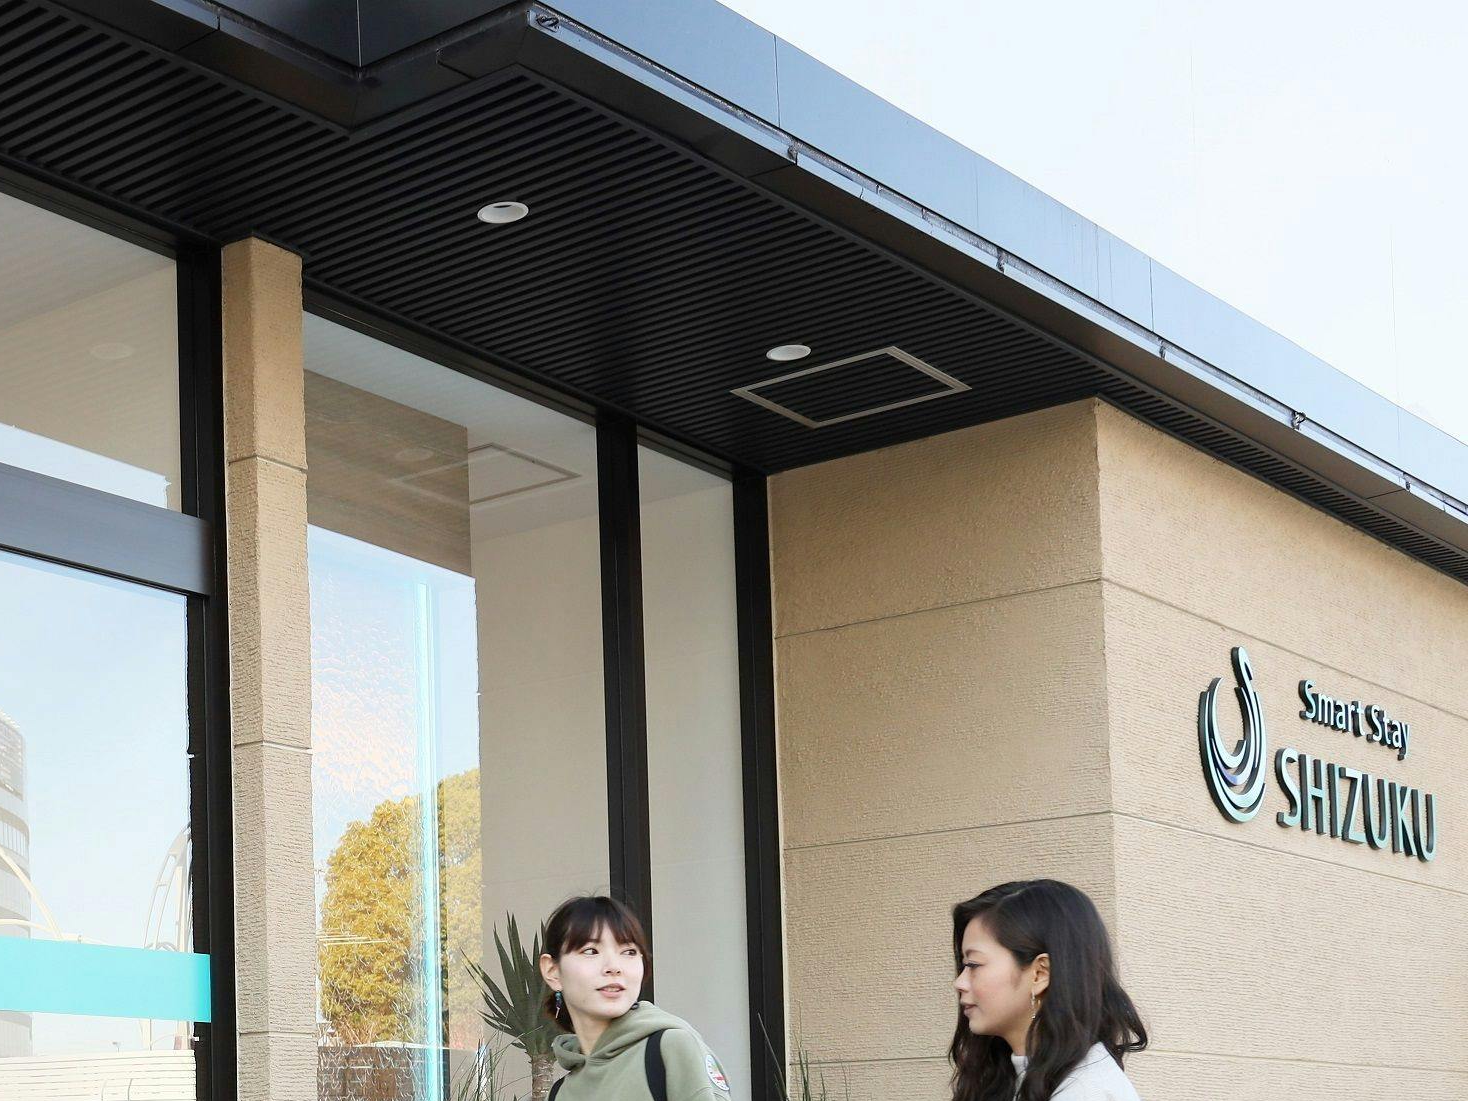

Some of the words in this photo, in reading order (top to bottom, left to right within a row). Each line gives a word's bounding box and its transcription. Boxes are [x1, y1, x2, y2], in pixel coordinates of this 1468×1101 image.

[1298, 679, 1365, 737] Smart
[1365, 703, 1411, 761] Stay
[1274, 747, 1437, 863] SHIZUKU
